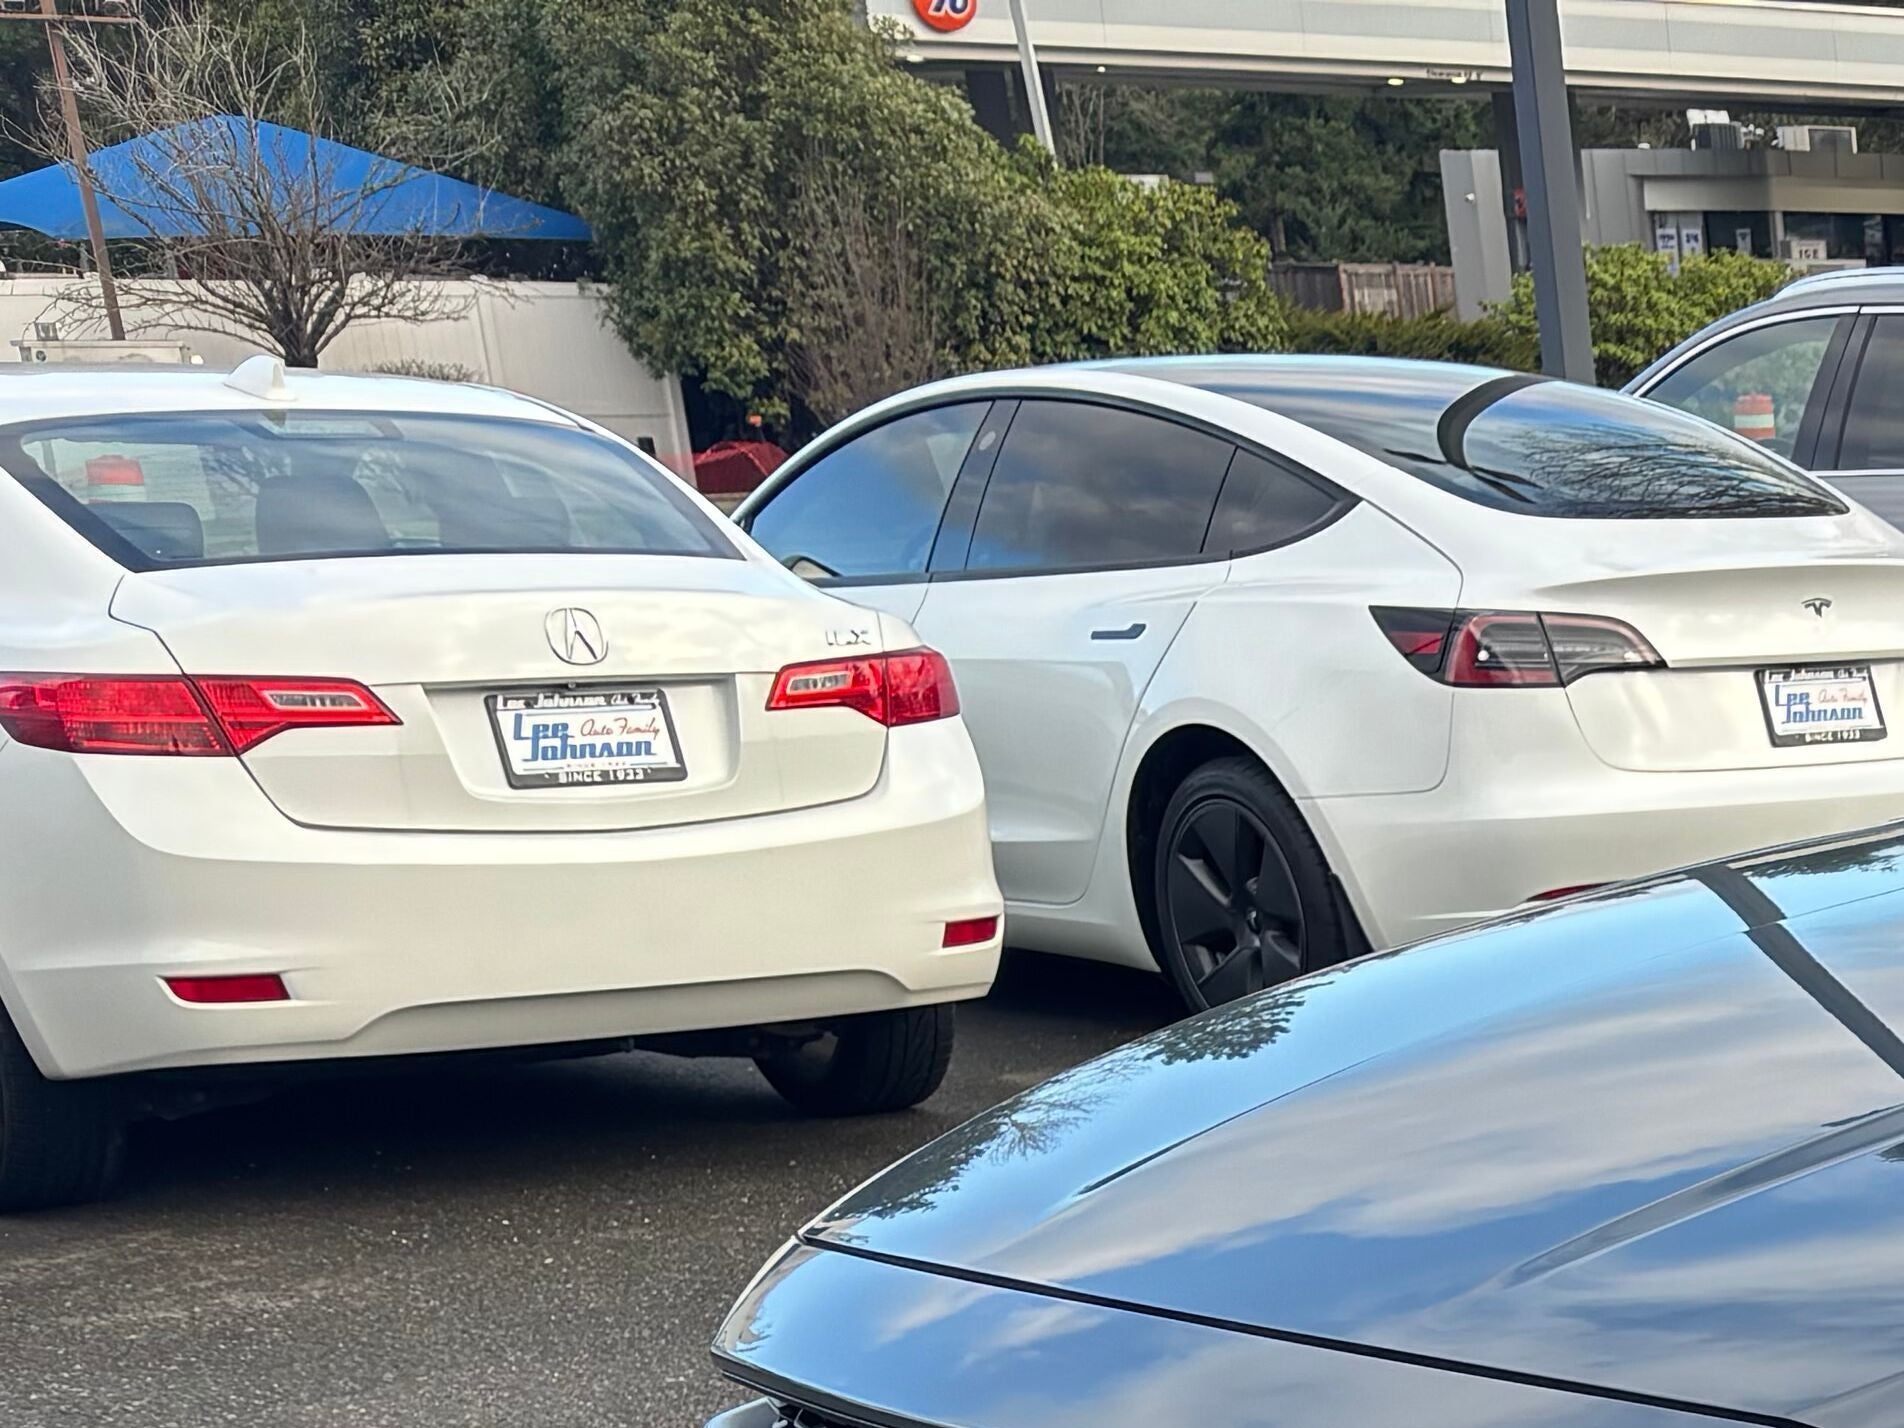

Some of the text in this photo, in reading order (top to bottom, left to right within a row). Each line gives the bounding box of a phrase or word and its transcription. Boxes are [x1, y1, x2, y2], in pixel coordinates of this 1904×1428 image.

[533, 692, 607, 709] Johnson
[1774, 684, 1812, 707] Lee
[1781, 702, 1864, 725] Johnson
[513, 713, 661, 744] Lee Auto Family
[521, 733, 658, 762] Johnson
